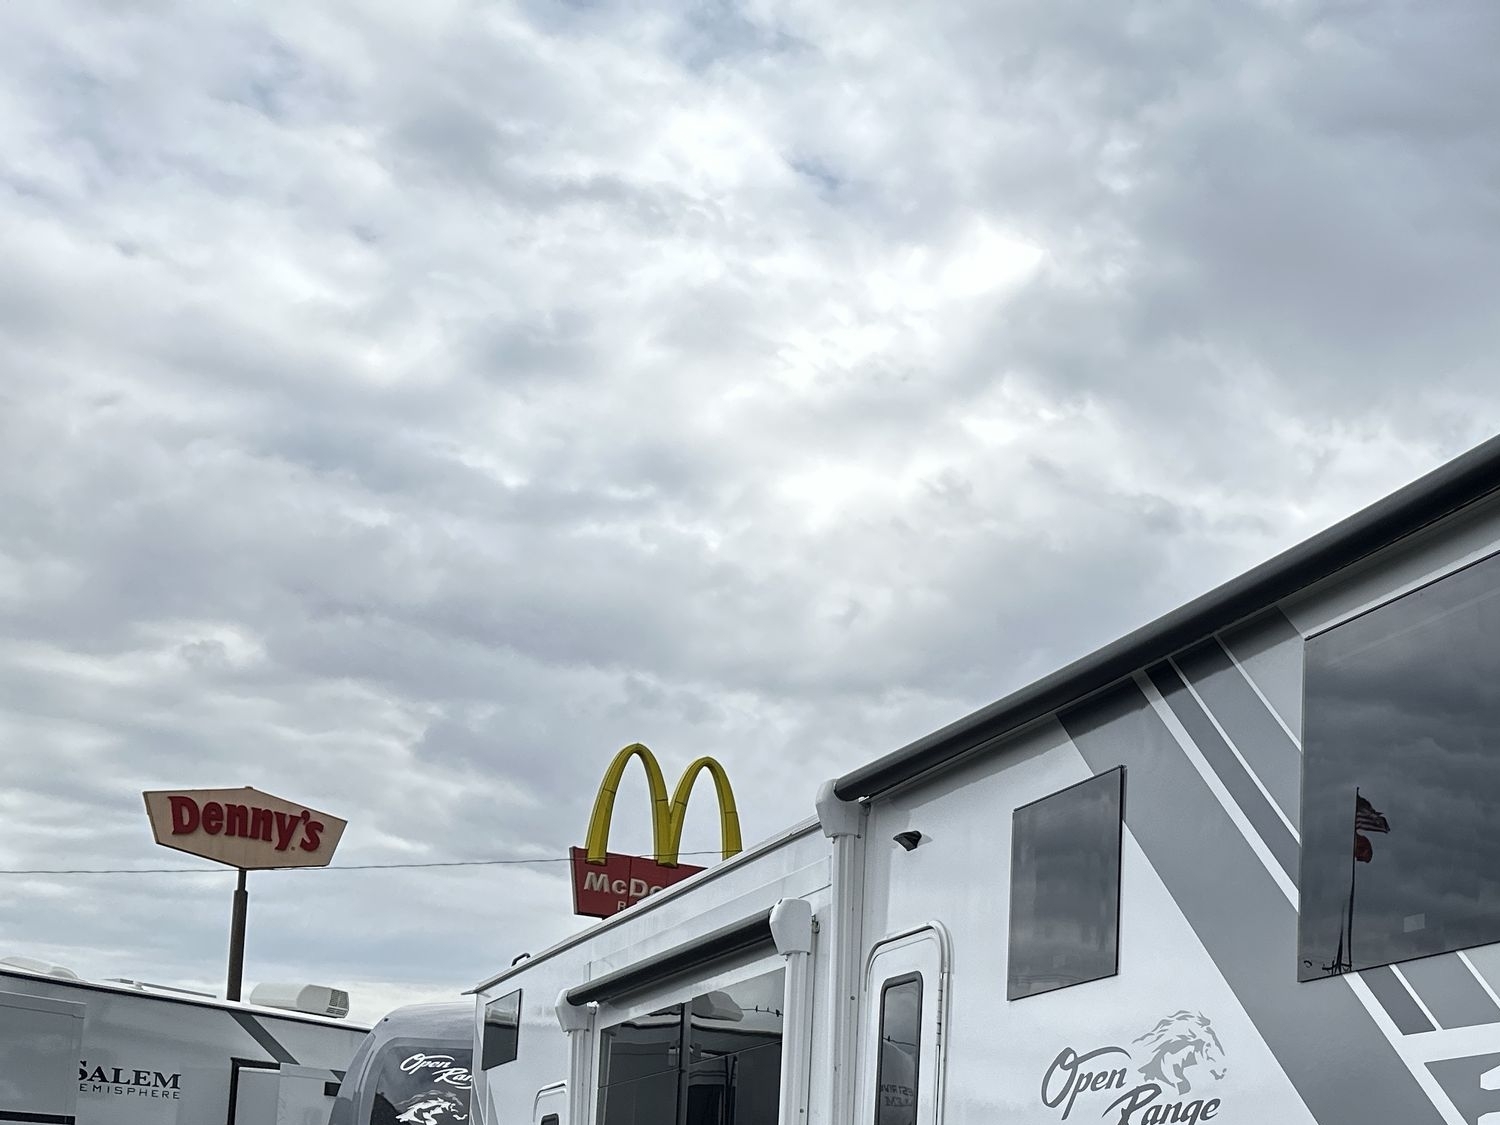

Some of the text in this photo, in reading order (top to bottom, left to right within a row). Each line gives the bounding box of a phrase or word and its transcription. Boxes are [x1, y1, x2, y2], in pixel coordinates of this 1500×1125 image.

[168, 796, 325, 853] Denny's
[400, 1053, 455, 1075] Open
[431, 1067, 473, 1089] Ran
[1041, 1046, 1132, 1121] Open
[79, 1083, 180, 1099] EMISPHERE
